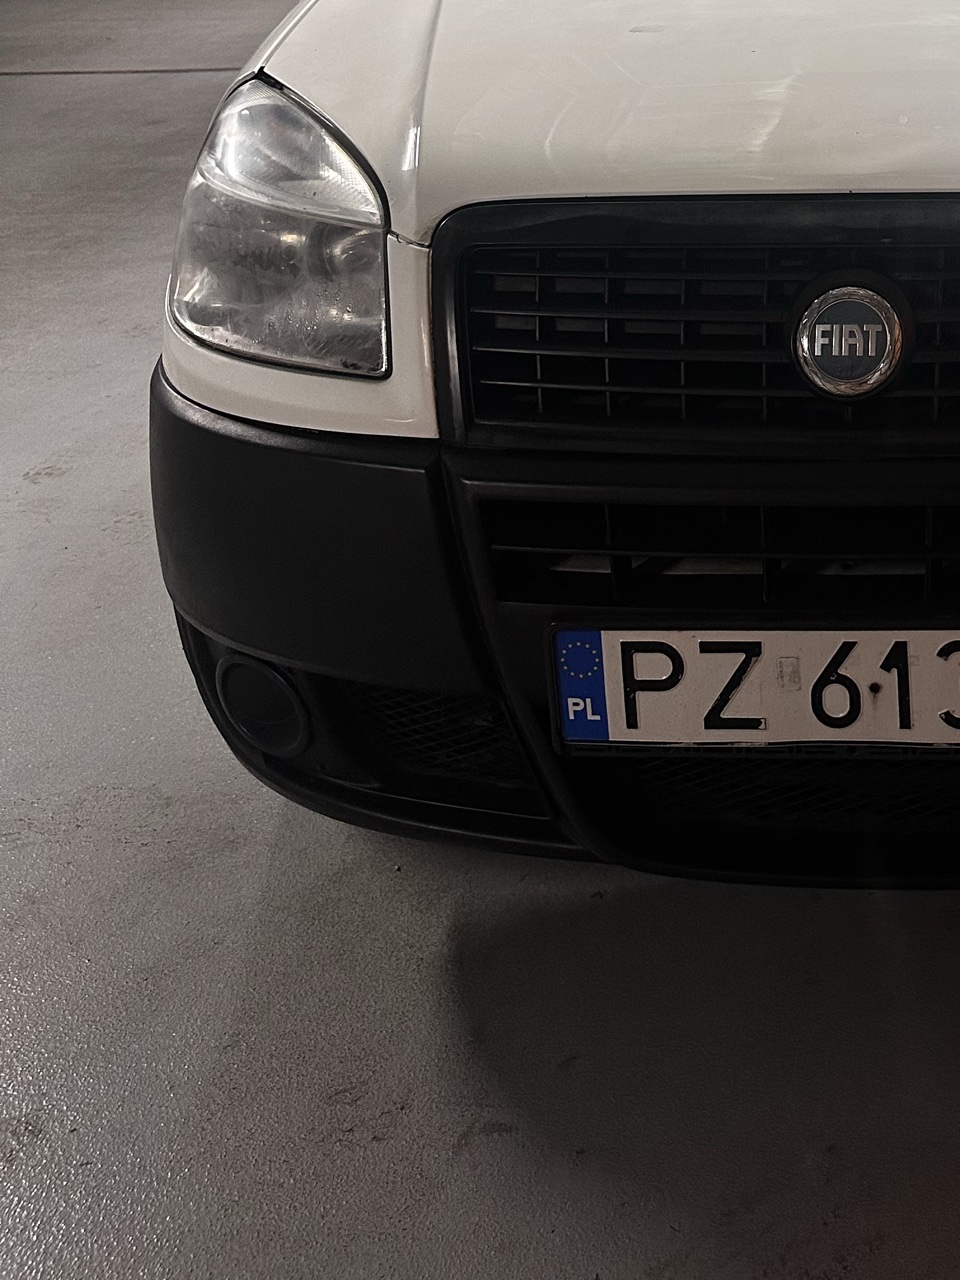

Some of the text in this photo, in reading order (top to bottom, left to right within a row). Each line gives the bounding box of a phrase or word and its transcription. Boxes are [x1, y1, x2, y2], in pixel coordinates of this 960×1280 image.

[814, 324, 883, 357] FIAT
[619, 640, 767, 730] PZ
[567, 697, 601, 720] PL
